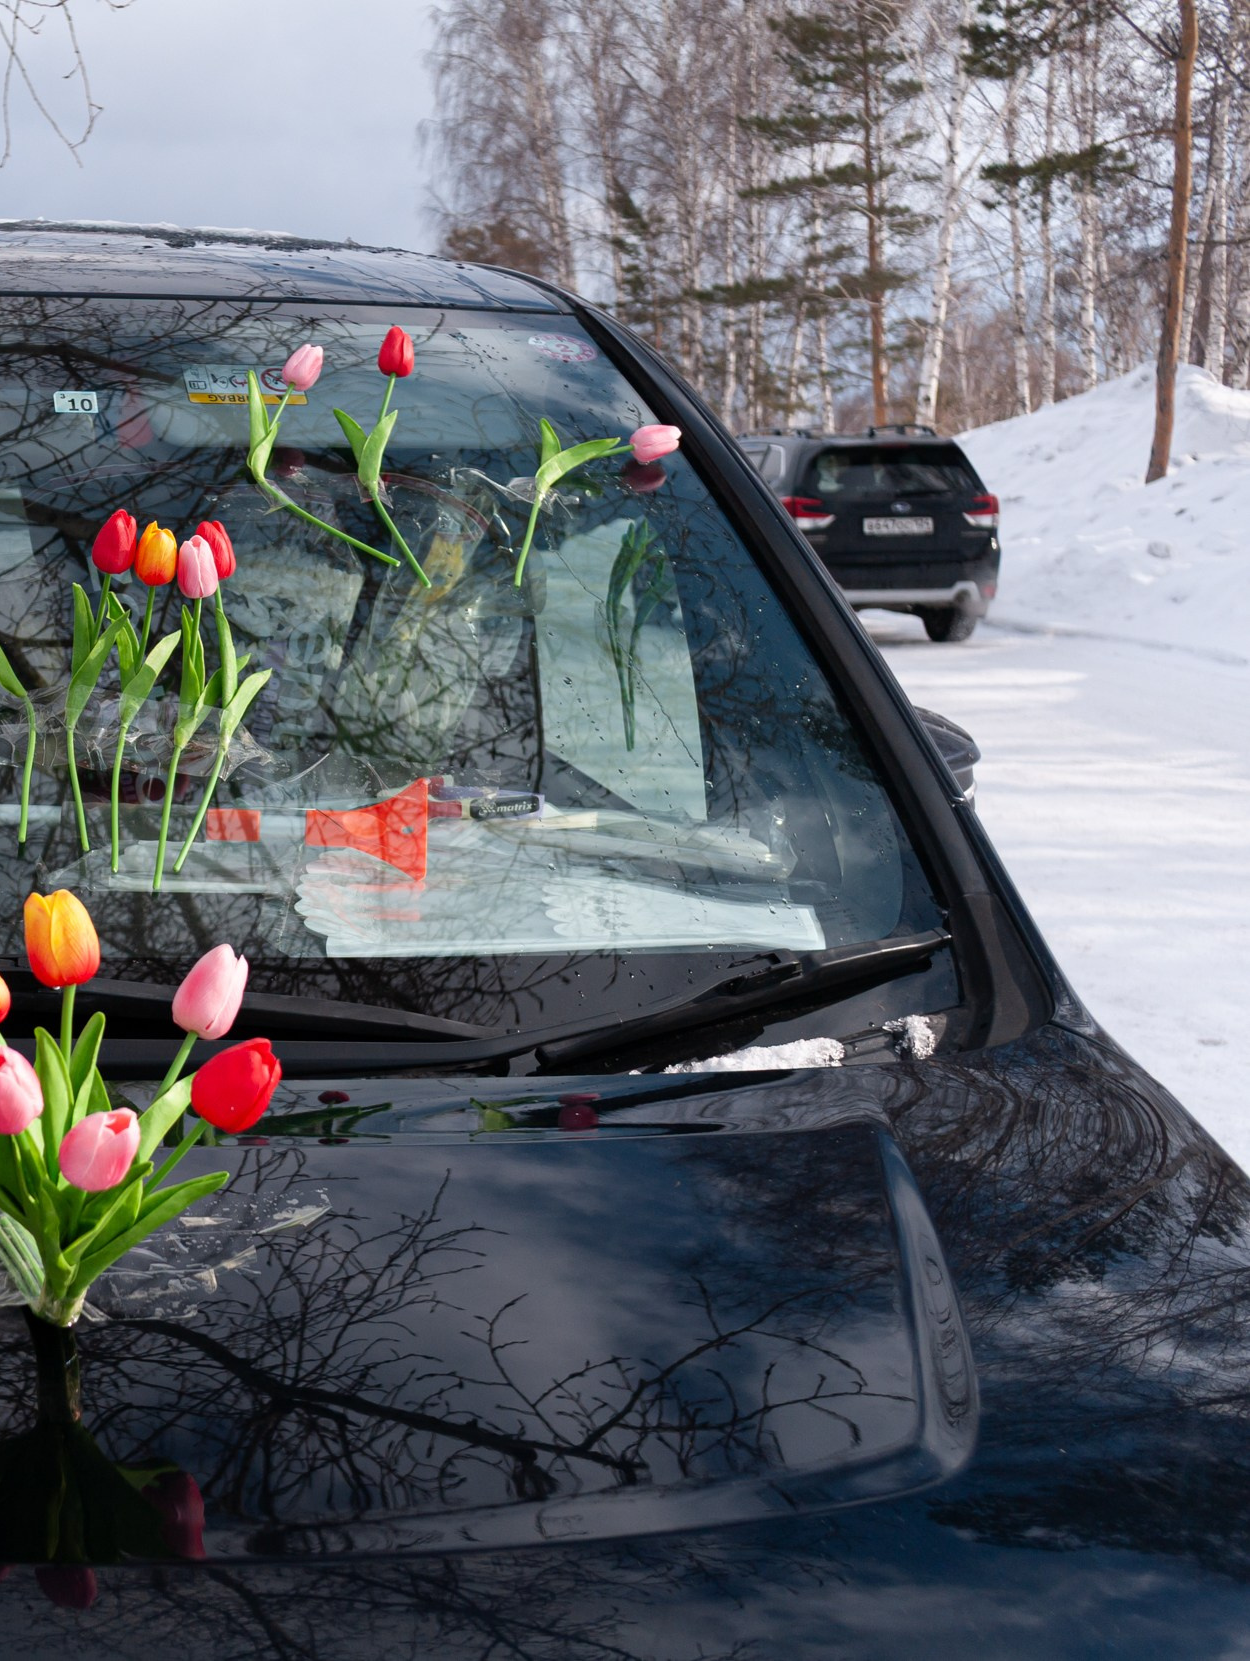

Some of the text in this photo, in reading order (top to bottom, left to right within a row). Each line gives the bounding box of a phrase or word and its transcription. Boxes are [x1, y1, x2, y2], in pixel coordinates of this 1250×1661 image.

[207, 394, 249, 403] RBAG
[67, 398, 93, 412] 10
[496, 801, 533, 812] matrix
